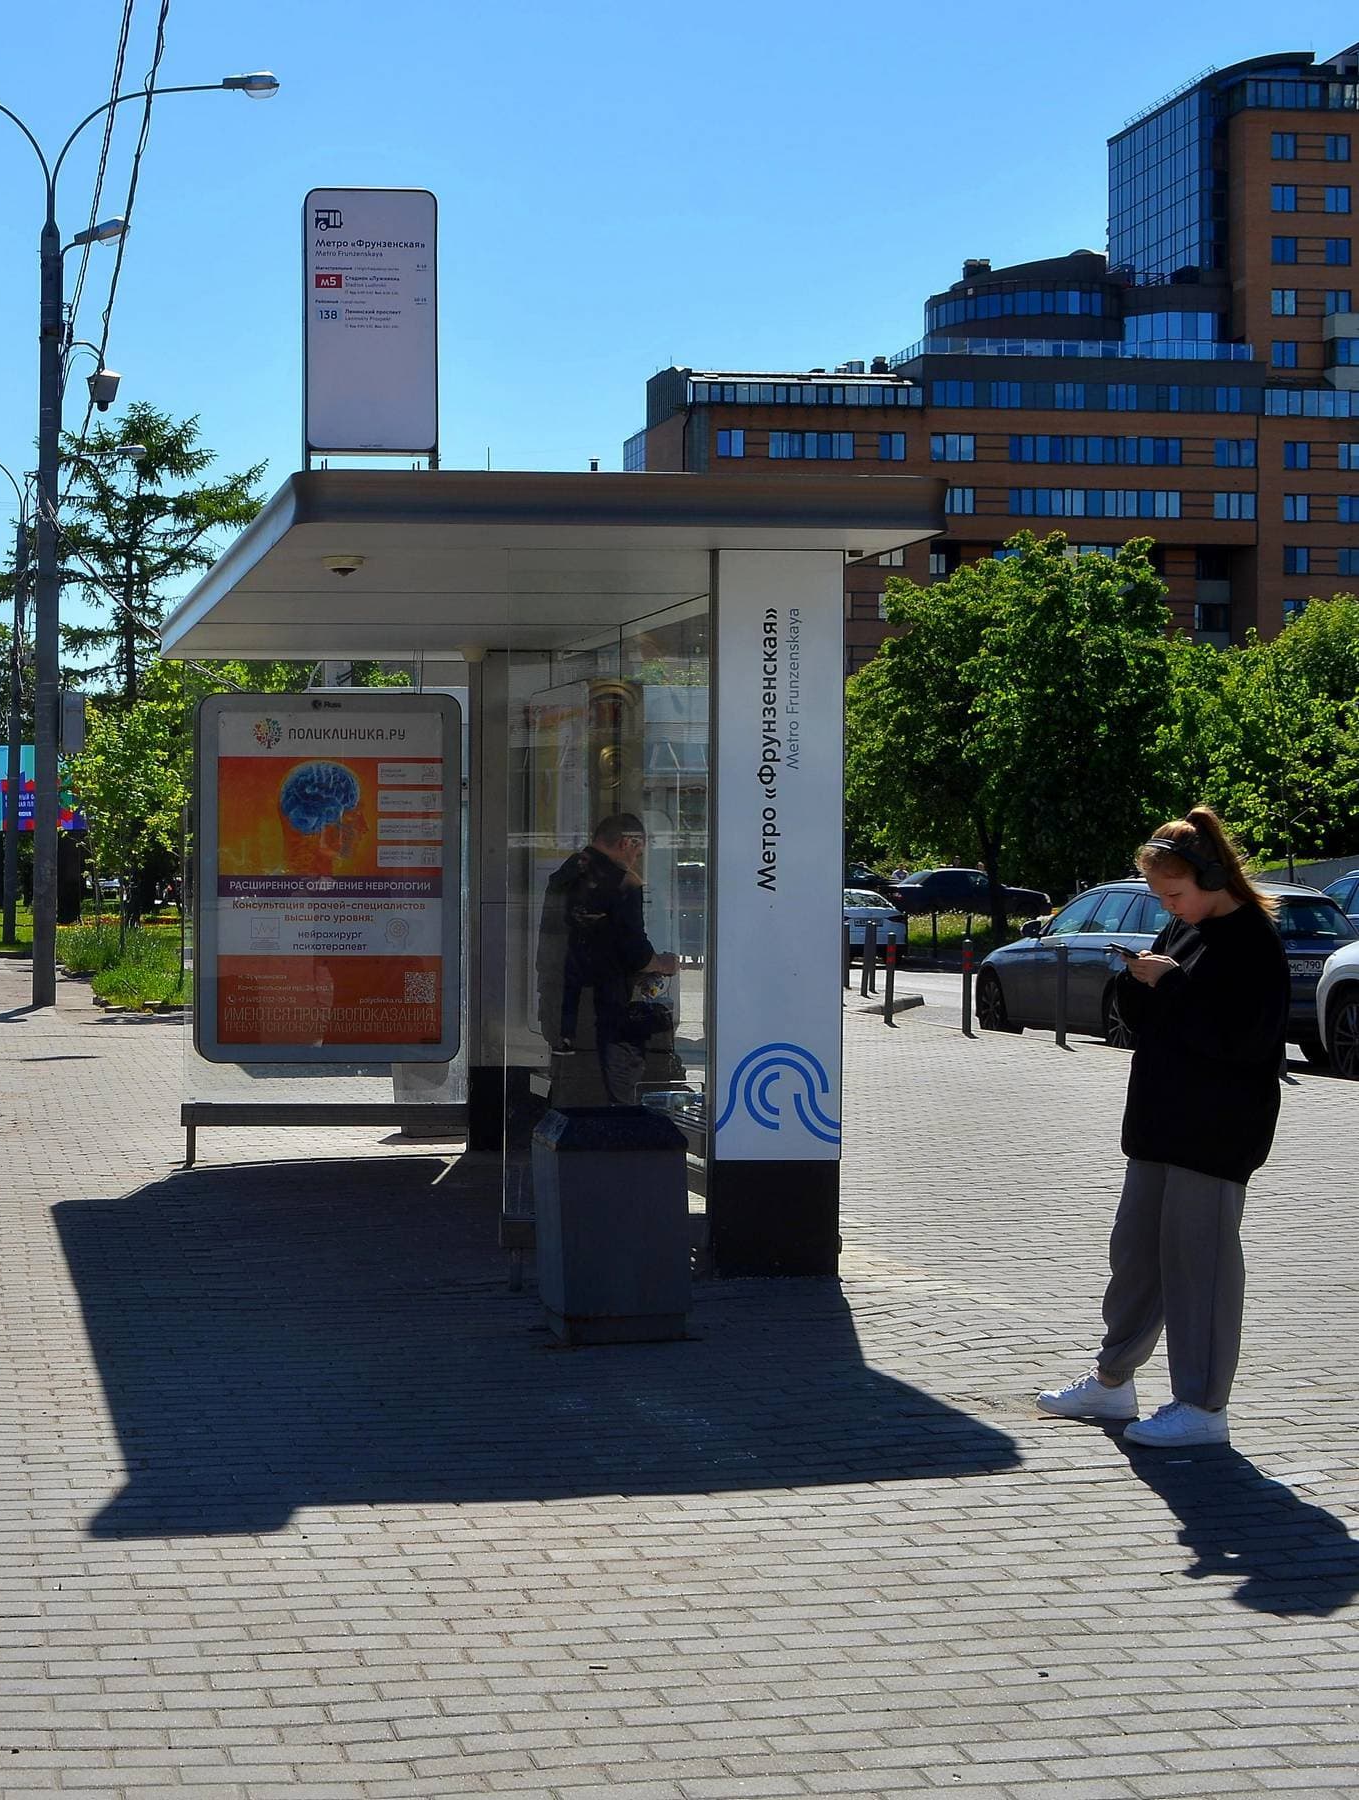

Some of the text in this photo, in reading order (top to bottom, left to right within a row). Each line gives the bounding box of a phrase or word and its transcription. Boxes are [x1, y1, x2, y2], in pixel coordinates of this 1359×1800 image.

[315, 239, 425, 249] Метро «Фрунзенская»
[338, 250, 383, 258] Frunzenskaya
[319, 310, 338, 320] 138
[785, 607, 803, 770] Metro Frunzenskaya
[288, 727, 406, 741] ПОЛИКЛИНИКА.РУ
[756, 607, 781, 891] Метро «Фрунзенская»
[230, 881, 431, 891] РАСШИРЕННОЕ ОТДЕЛЕНИЕ НЕВРОЛОГИИ
[232, 900, 426, 912] Консультация врачей-специалистов
[284, 913, 374, 924] высшего уровня:
[298, 929, 362, 940] нейрохирург
[293, 942, 367, 952] психотерапевт
[1304, 960, 1321, 969] 790
[224, 1007, 291, 1021] ИМЕЮТСЯ
[283, 1022, 361, 1033] КОНСУЛЬТАЦИЯ
[362, 1022, 436, 1033] СПЕЦИАЛИСТА
